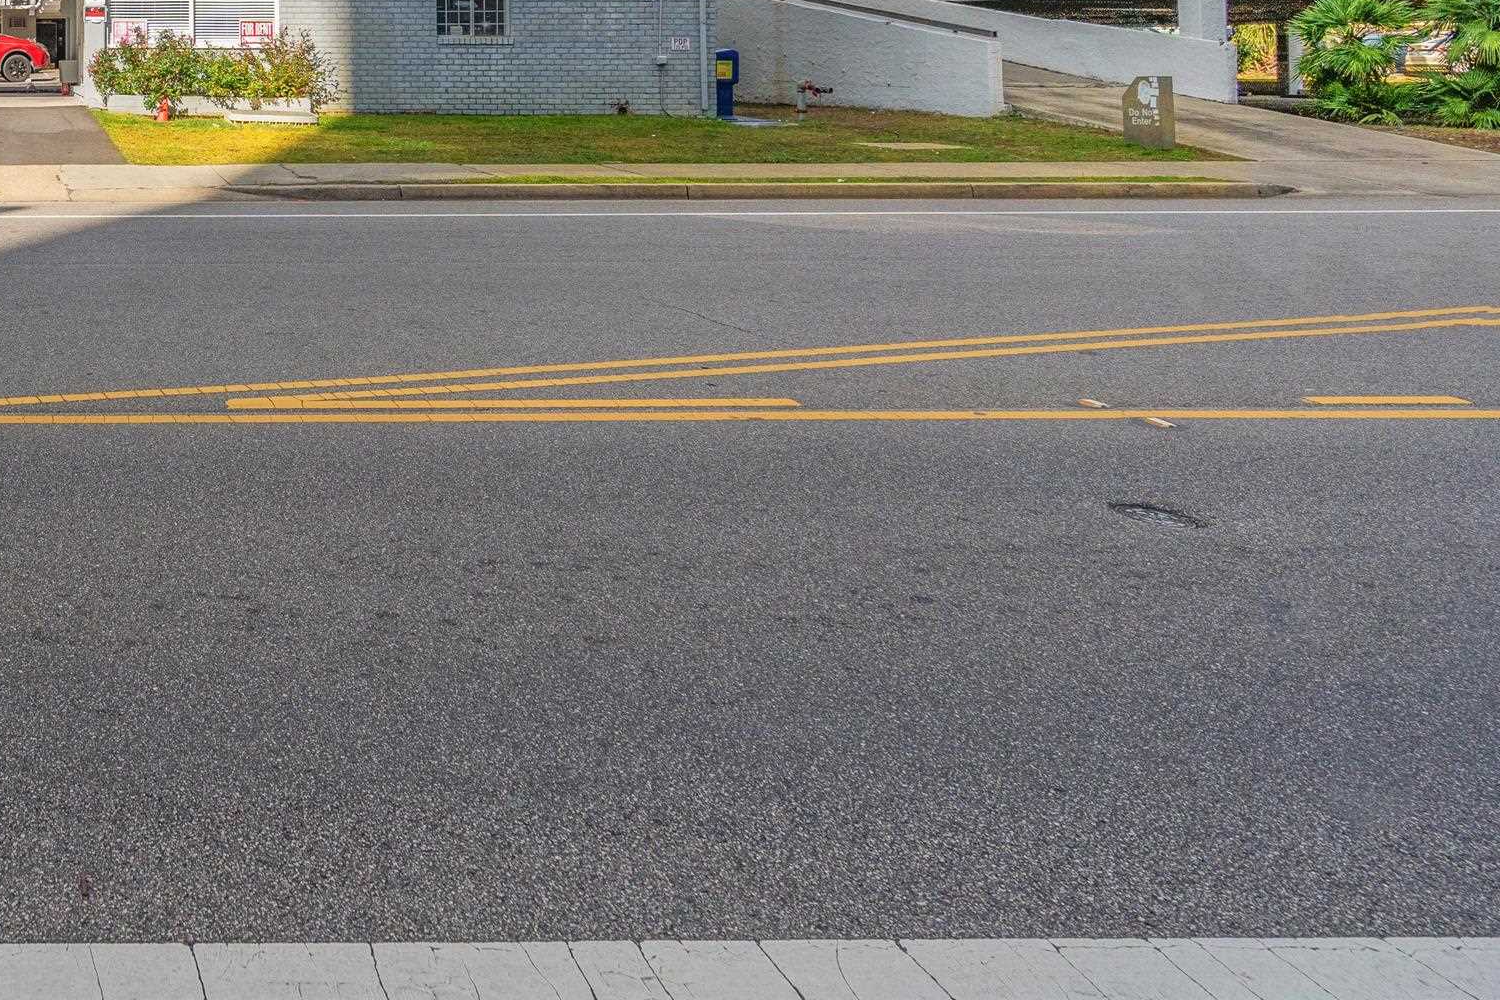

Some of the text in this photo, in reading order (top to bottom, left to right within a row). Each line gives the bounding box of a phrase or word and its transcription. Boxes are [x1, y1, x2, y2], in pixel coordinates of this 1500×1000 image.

[243, 23, 272, 36] FOR RENT
[1128, 108, 1140, 117] Do
[1132, 117, 1152, 126] Enter
